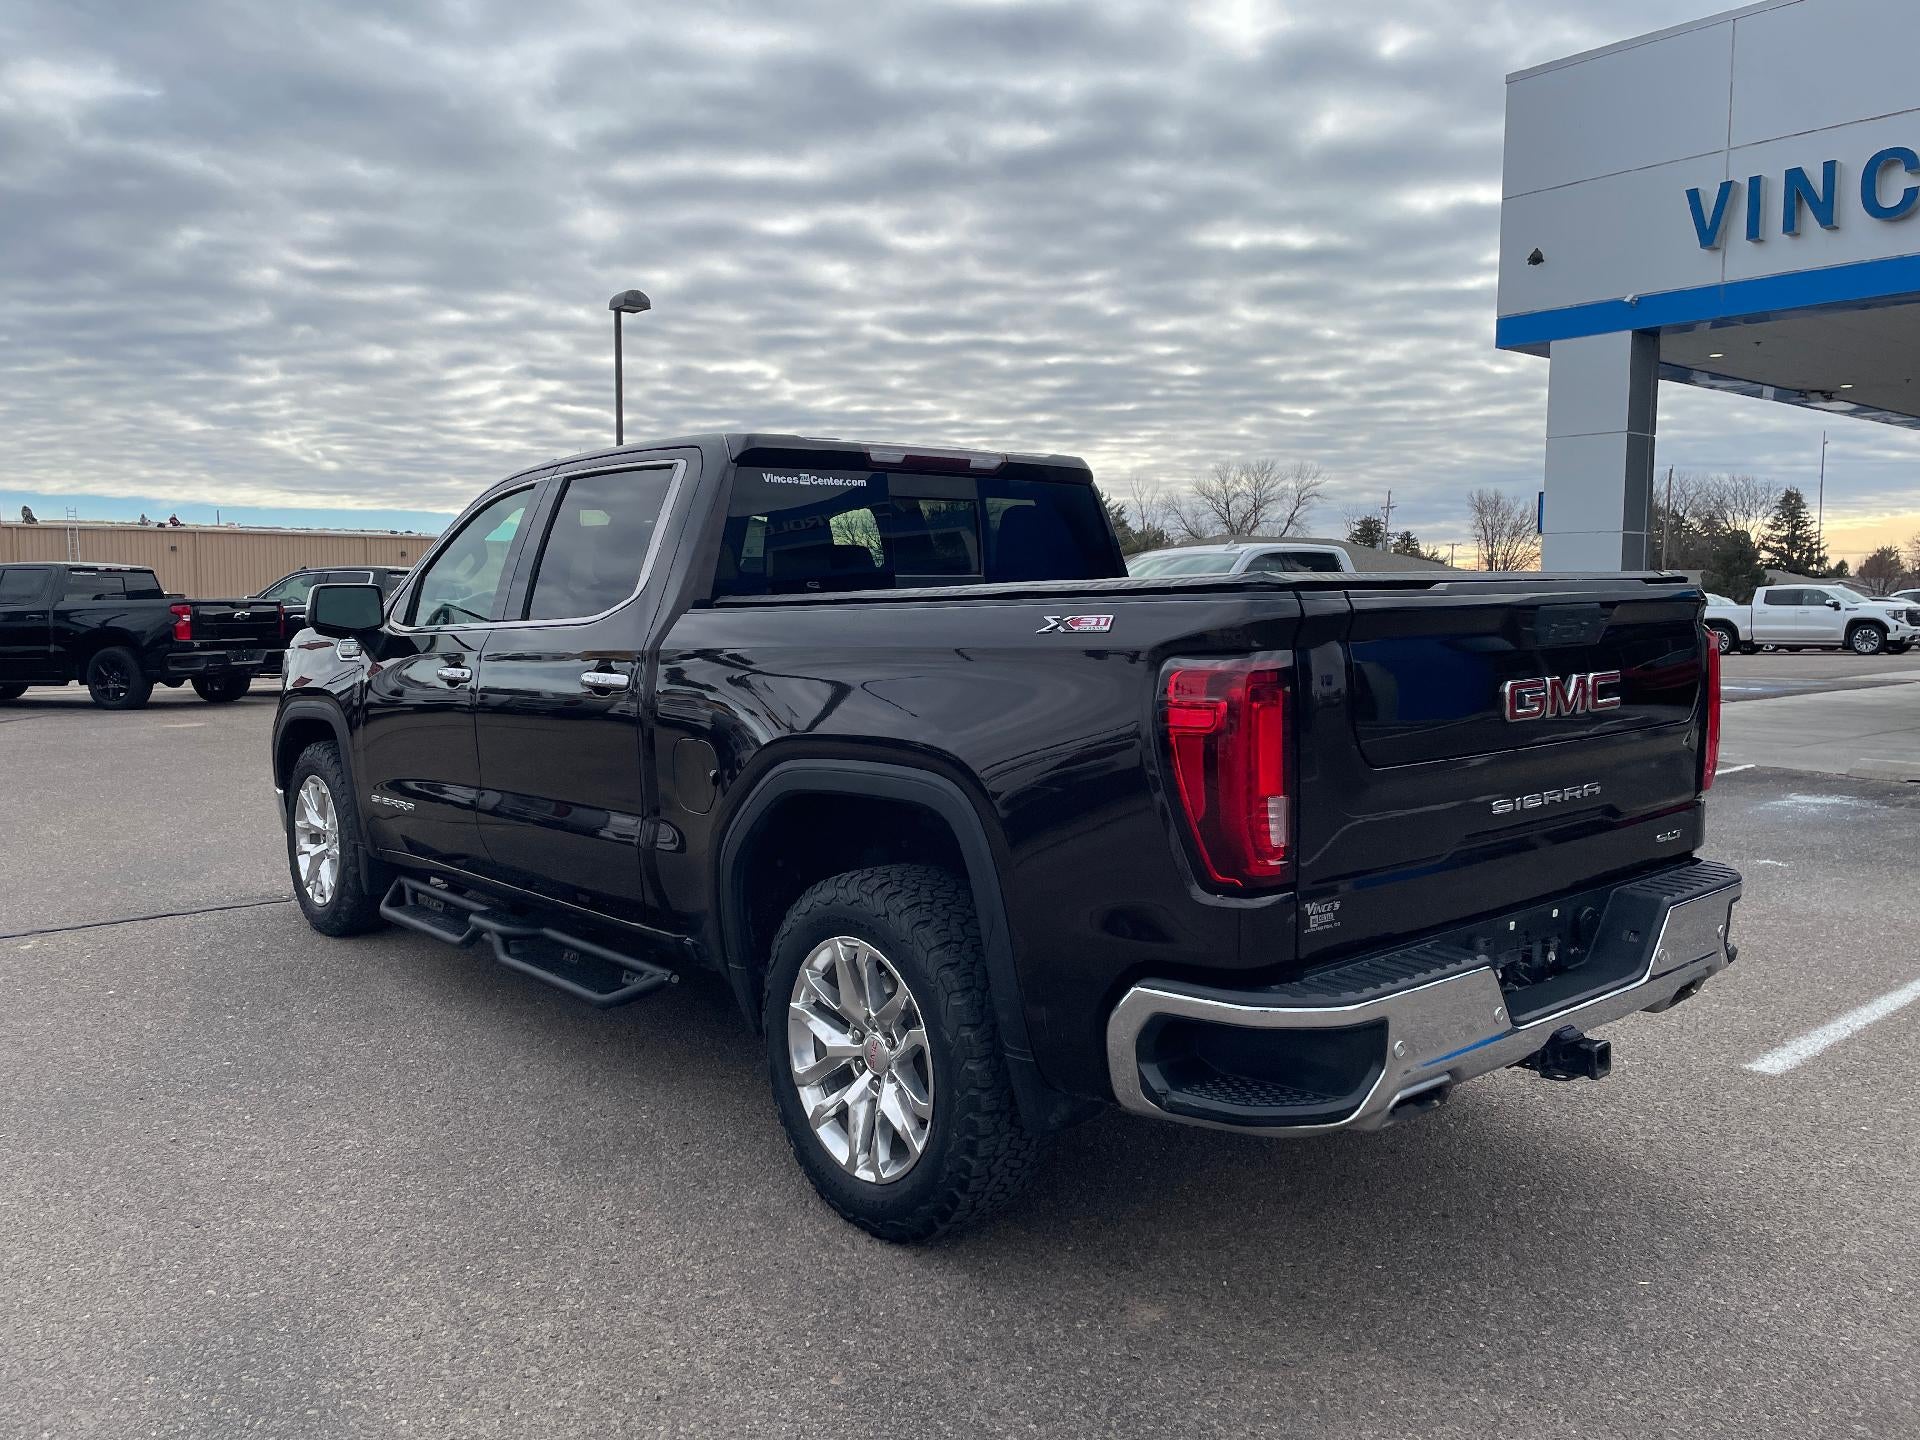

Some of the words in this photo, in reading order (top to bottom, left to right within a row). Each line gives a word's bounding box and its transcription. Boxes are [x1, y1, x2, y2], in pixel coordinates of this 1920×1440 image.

[1686, 146, 1920, 250] VINC
[1503, 670, 1621, 723] GMC
[371, 795, 415, 811] SIERRA
[1491, 781, 1600, 815] SIERRA
